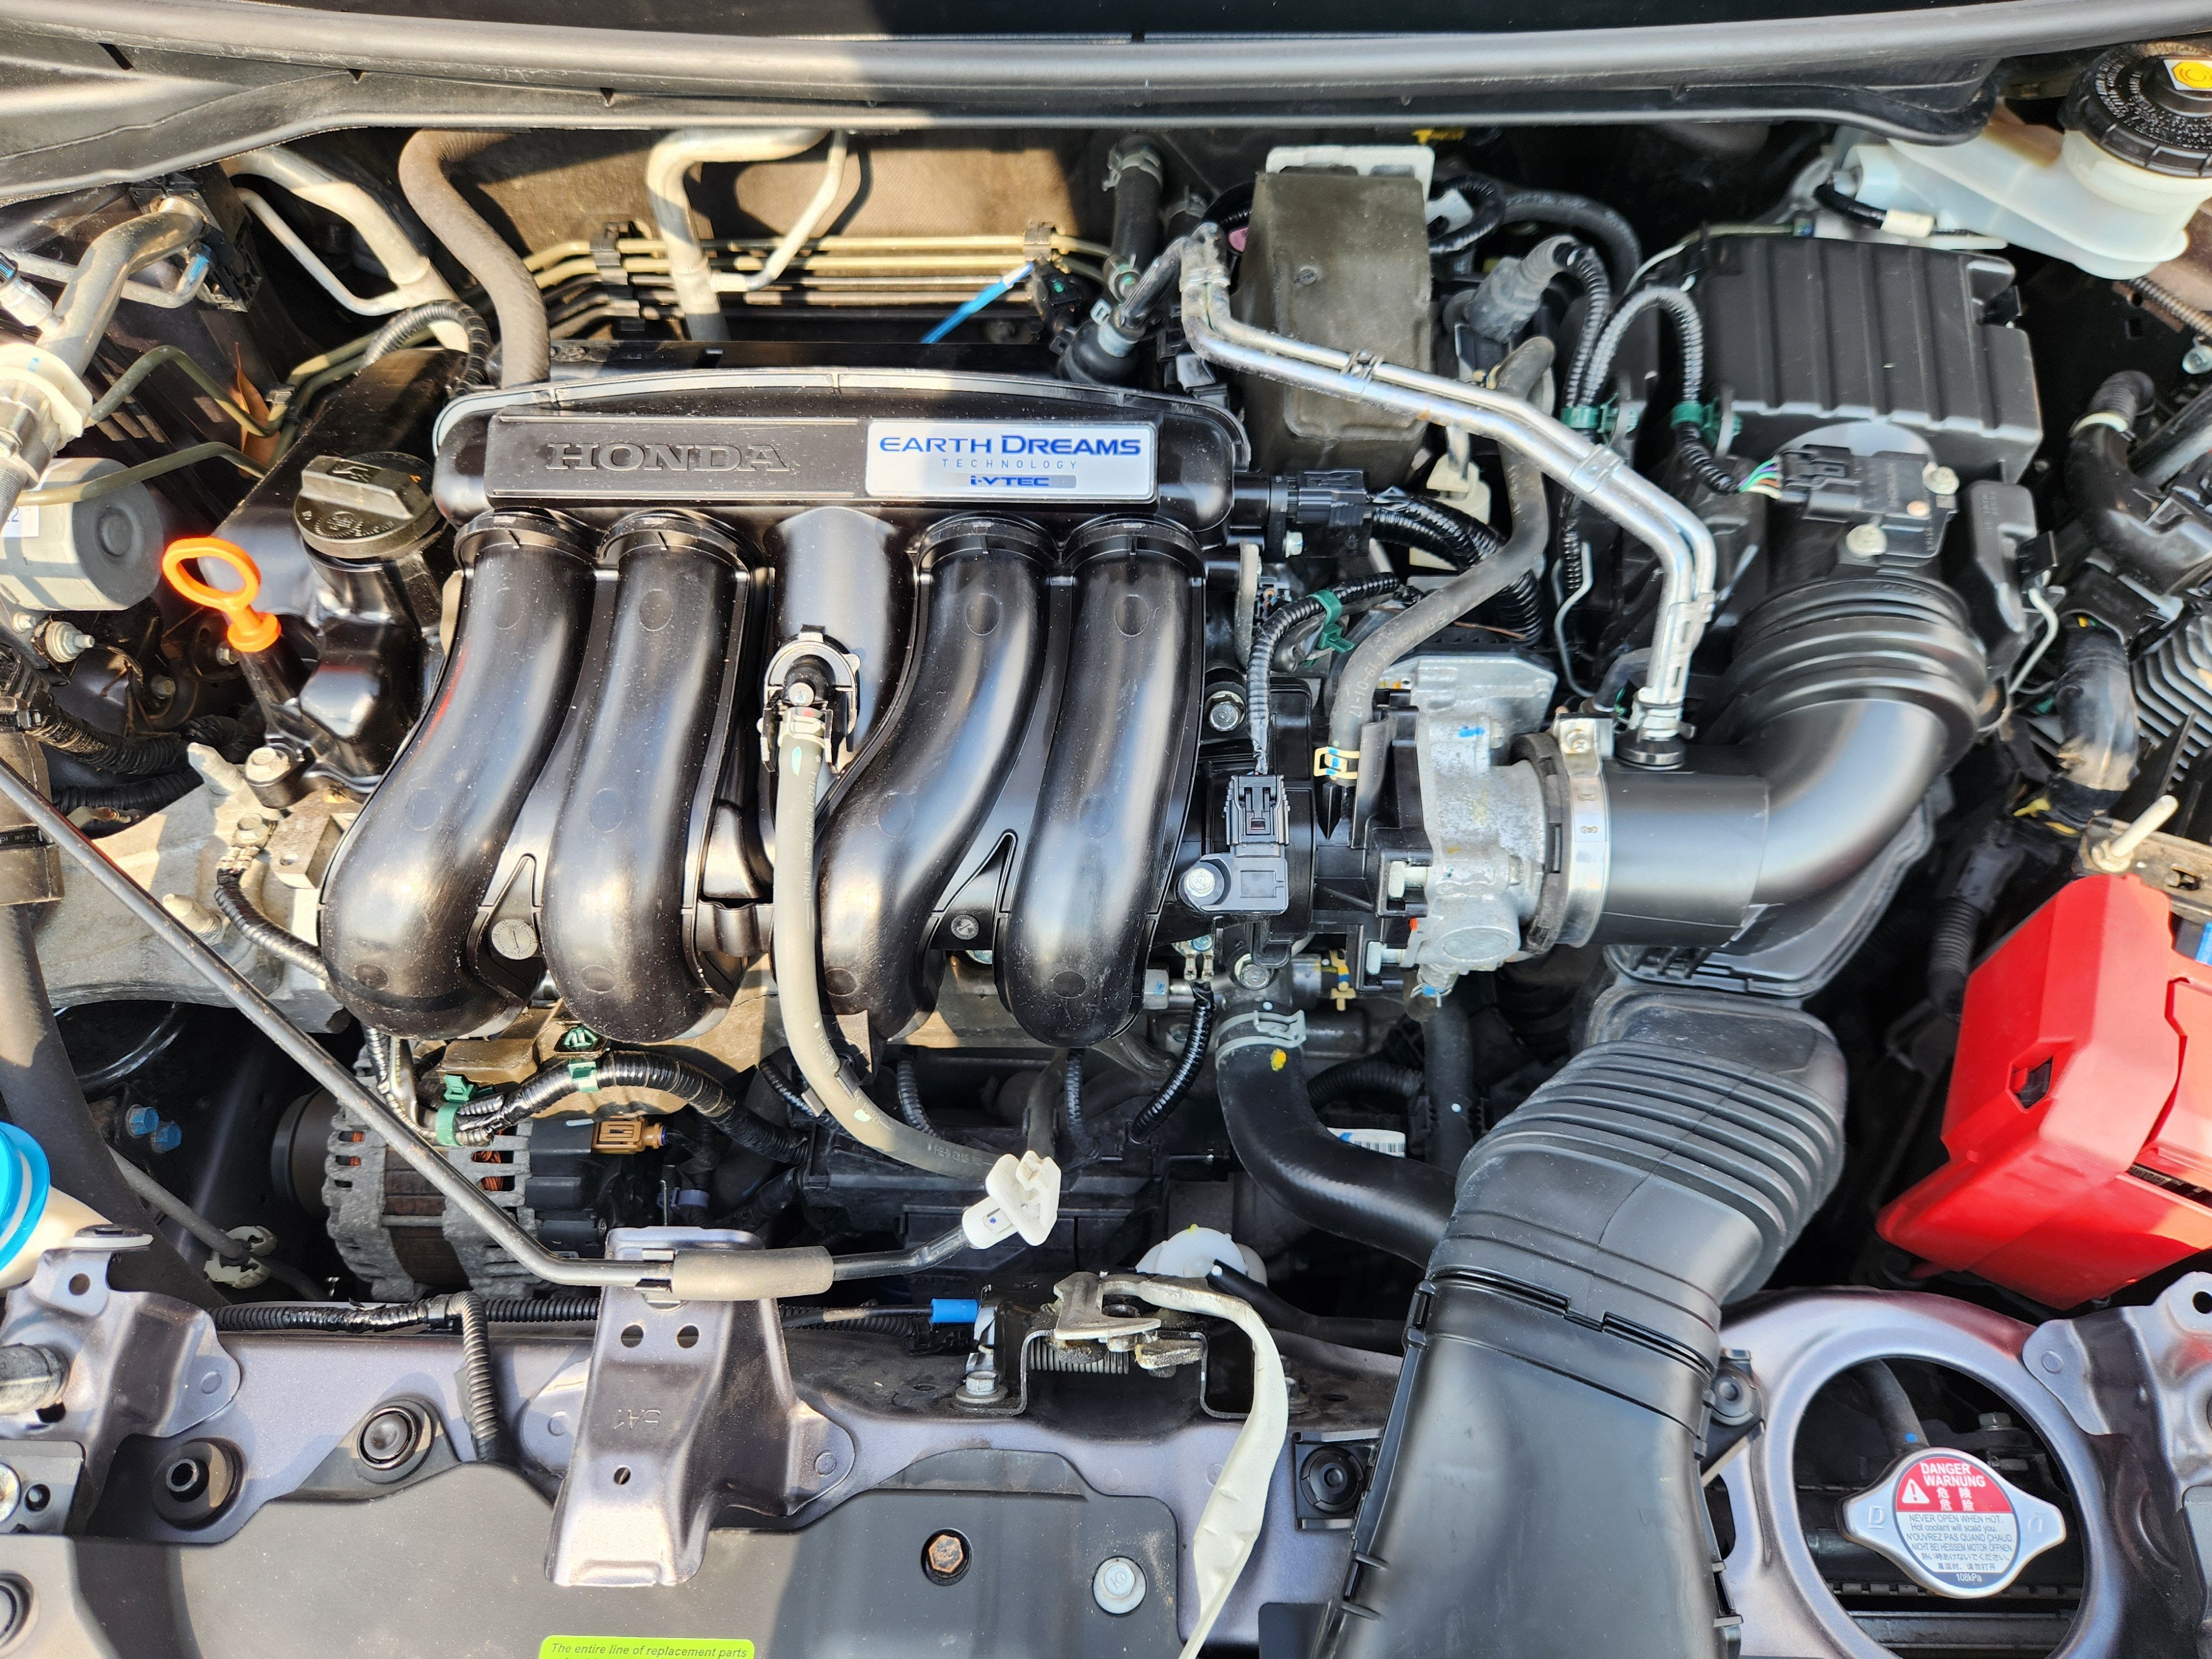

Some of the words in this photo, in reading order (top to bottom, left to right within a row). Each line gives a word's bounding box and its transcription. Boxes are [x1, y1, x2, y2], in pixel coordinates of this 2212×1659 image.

[879, 437, 992, 453] EARTH
[1000, 434, 1142, 456] DREAMS
[546, 442, 790, 472] HONDA
[942, 458, 1078, 469] TECHNOLOGY
[970, 474, 1050, 487] i-VTEC
[804, 870, 812, 901] 190321
[1920, 1463, 1971, 1475] DANGER
[1923, 1475, 1986, 1487] WARNUNG
[1937, 1514, 1959, 1522] OPEN
[1964, 1524, 1981, 1532] scald
[1906, 1533, 1943, 1541] N'OUVREZ
[1944, 1533, 1959, 1541] PAS
[1960, 1533, 1985, 1542] QUAND
[1987, 1534, 2015, 1542] CHAUD.
[1911, 1542, 1929, 1551] NICHT
[1966, 1543, 1989, 1551] MOTOR
[1956, 1573, 1983, 1582] 108kPa
[552, 1643, 571, 1653] The
[575, 1644, 606, 1653] entire
[609, 1645, 629, 1654] line
[633, 1645, 646, 1655] of
[646, 1646, 717, 1658] replacement
[718, 1647, 748, 1659] parts
